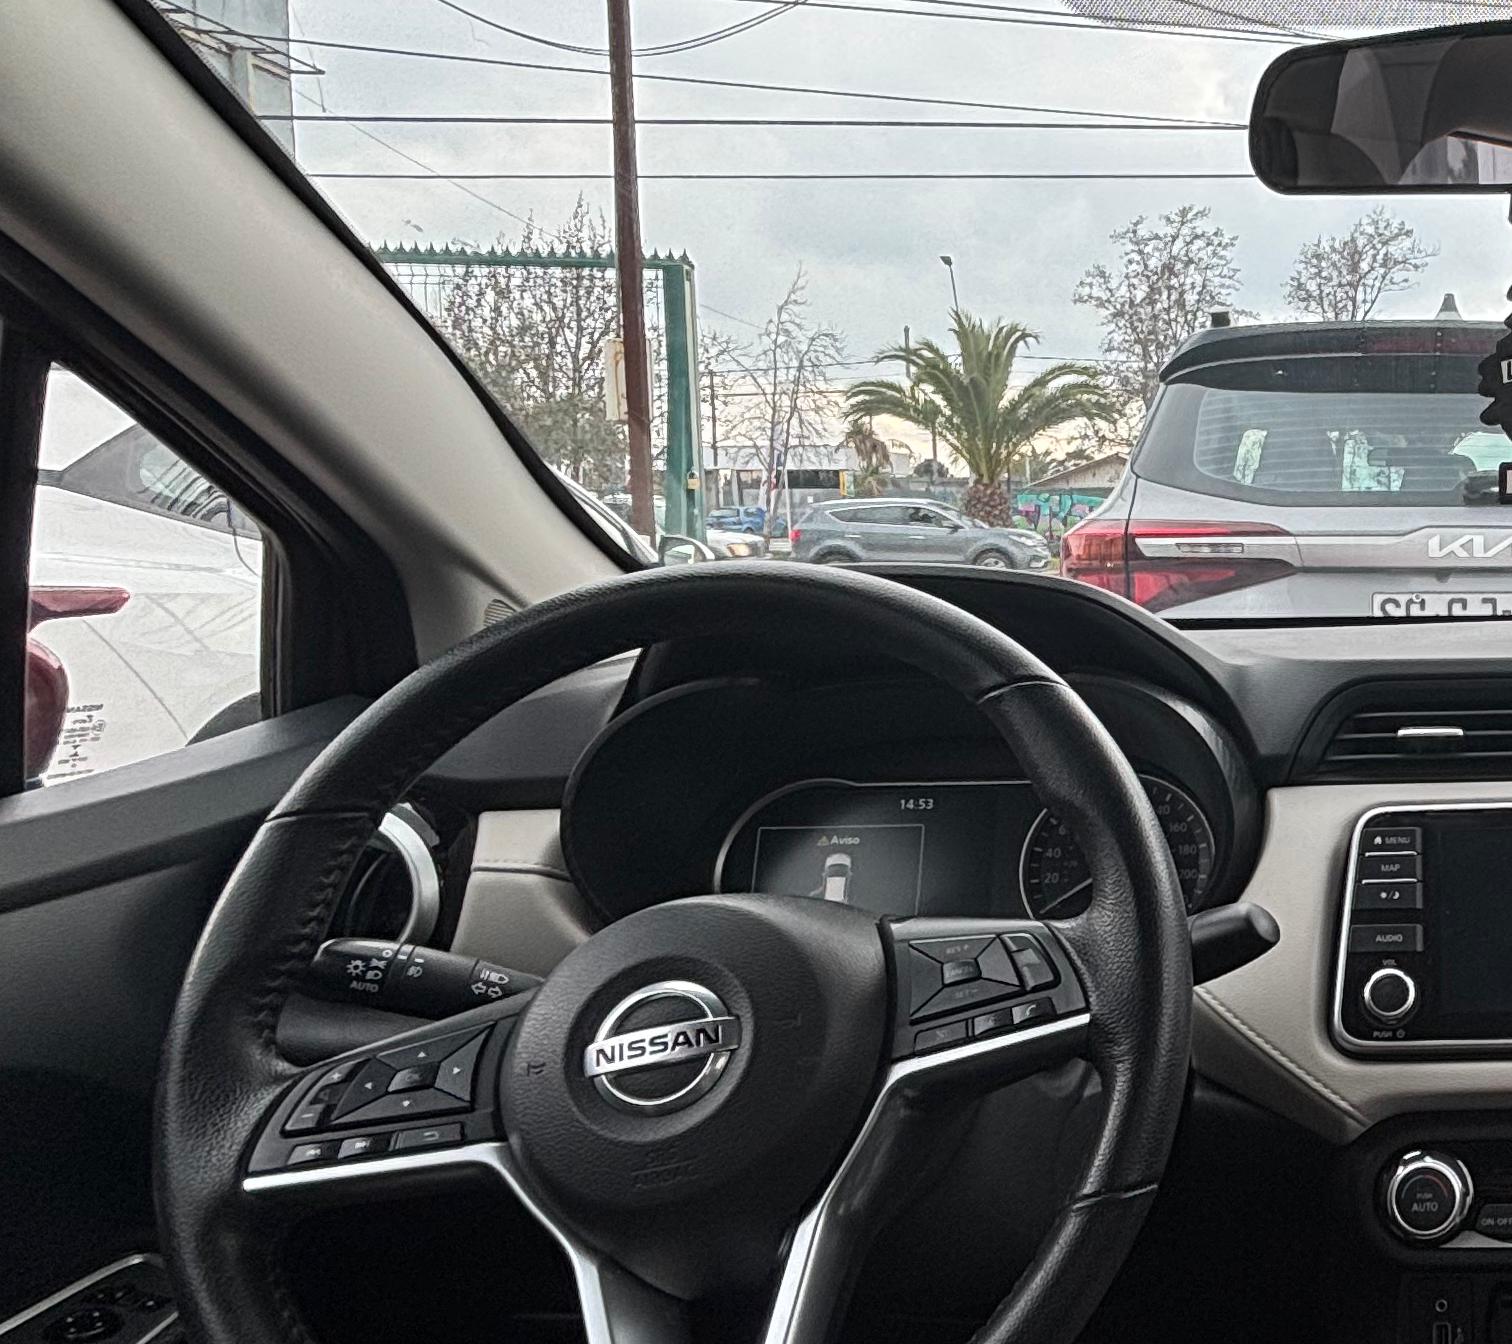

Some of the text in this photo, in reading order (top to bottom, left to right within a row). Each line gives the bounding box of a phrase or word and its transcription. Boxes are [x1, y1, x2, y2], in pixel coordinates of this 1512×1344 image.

[900, 798, 934, 810] 14:53
[830, 835, 861, 845] Aviso
[1385, 836, 1411, 844] MENU
[1380, 864, 1401, 872] MAP
[1375, 934, 1403, 943] AUDIO
[349, 980, 380, 993] AUTO
[596, 1025, 721, 1067] NISSAN
[1411, 1201, 1439, 1212] AUTO
